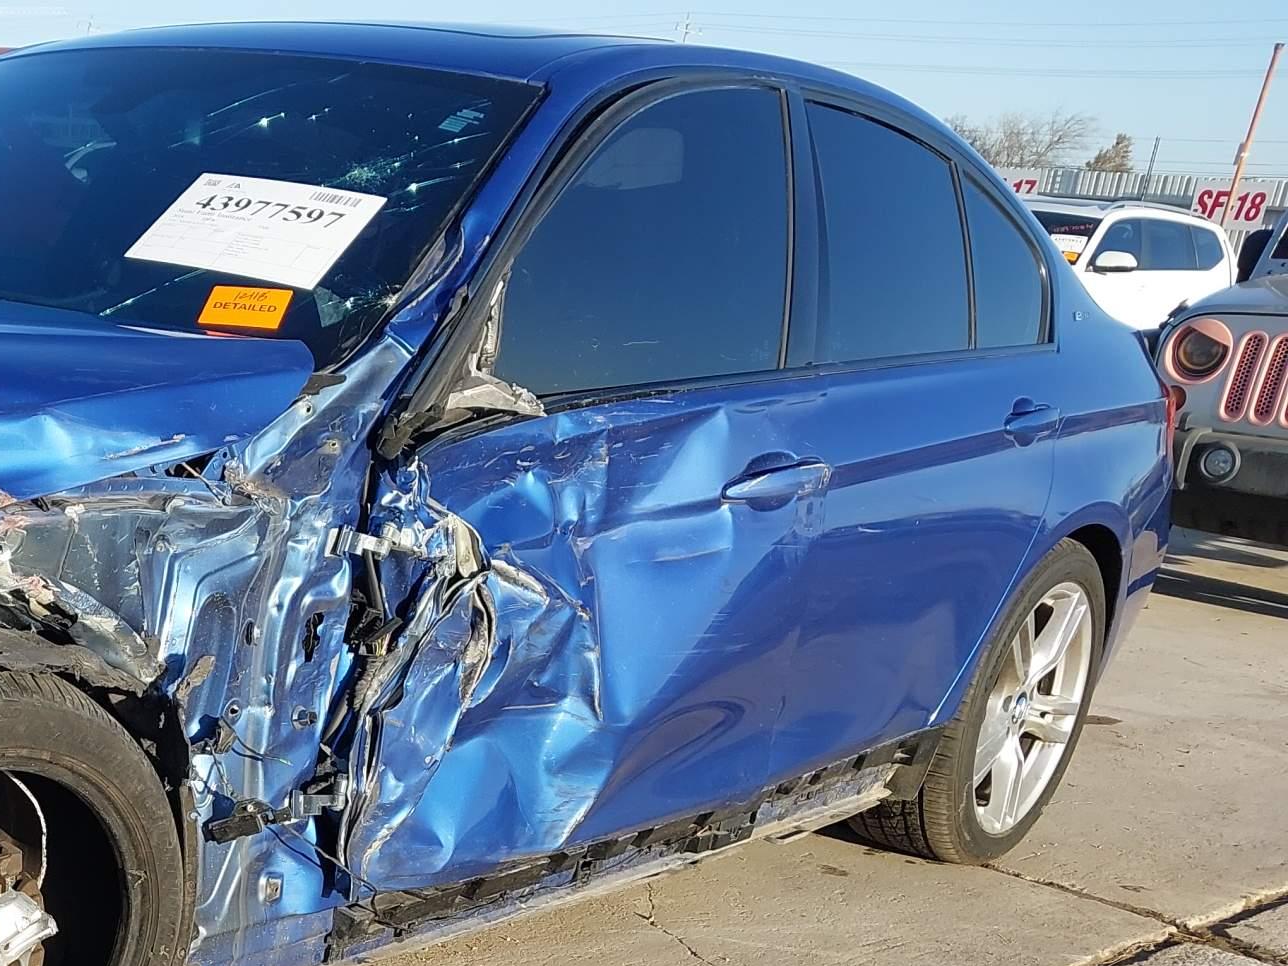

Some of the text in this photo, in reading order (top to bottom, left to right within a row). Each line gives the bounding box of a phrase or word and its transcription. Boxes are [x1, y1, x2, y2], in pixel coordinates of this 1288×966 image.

[195, 193, 346, 229] 43977597
[1193, 189, 1267, 222] SF 18
[213, 301, 278, 313] DETAILED
